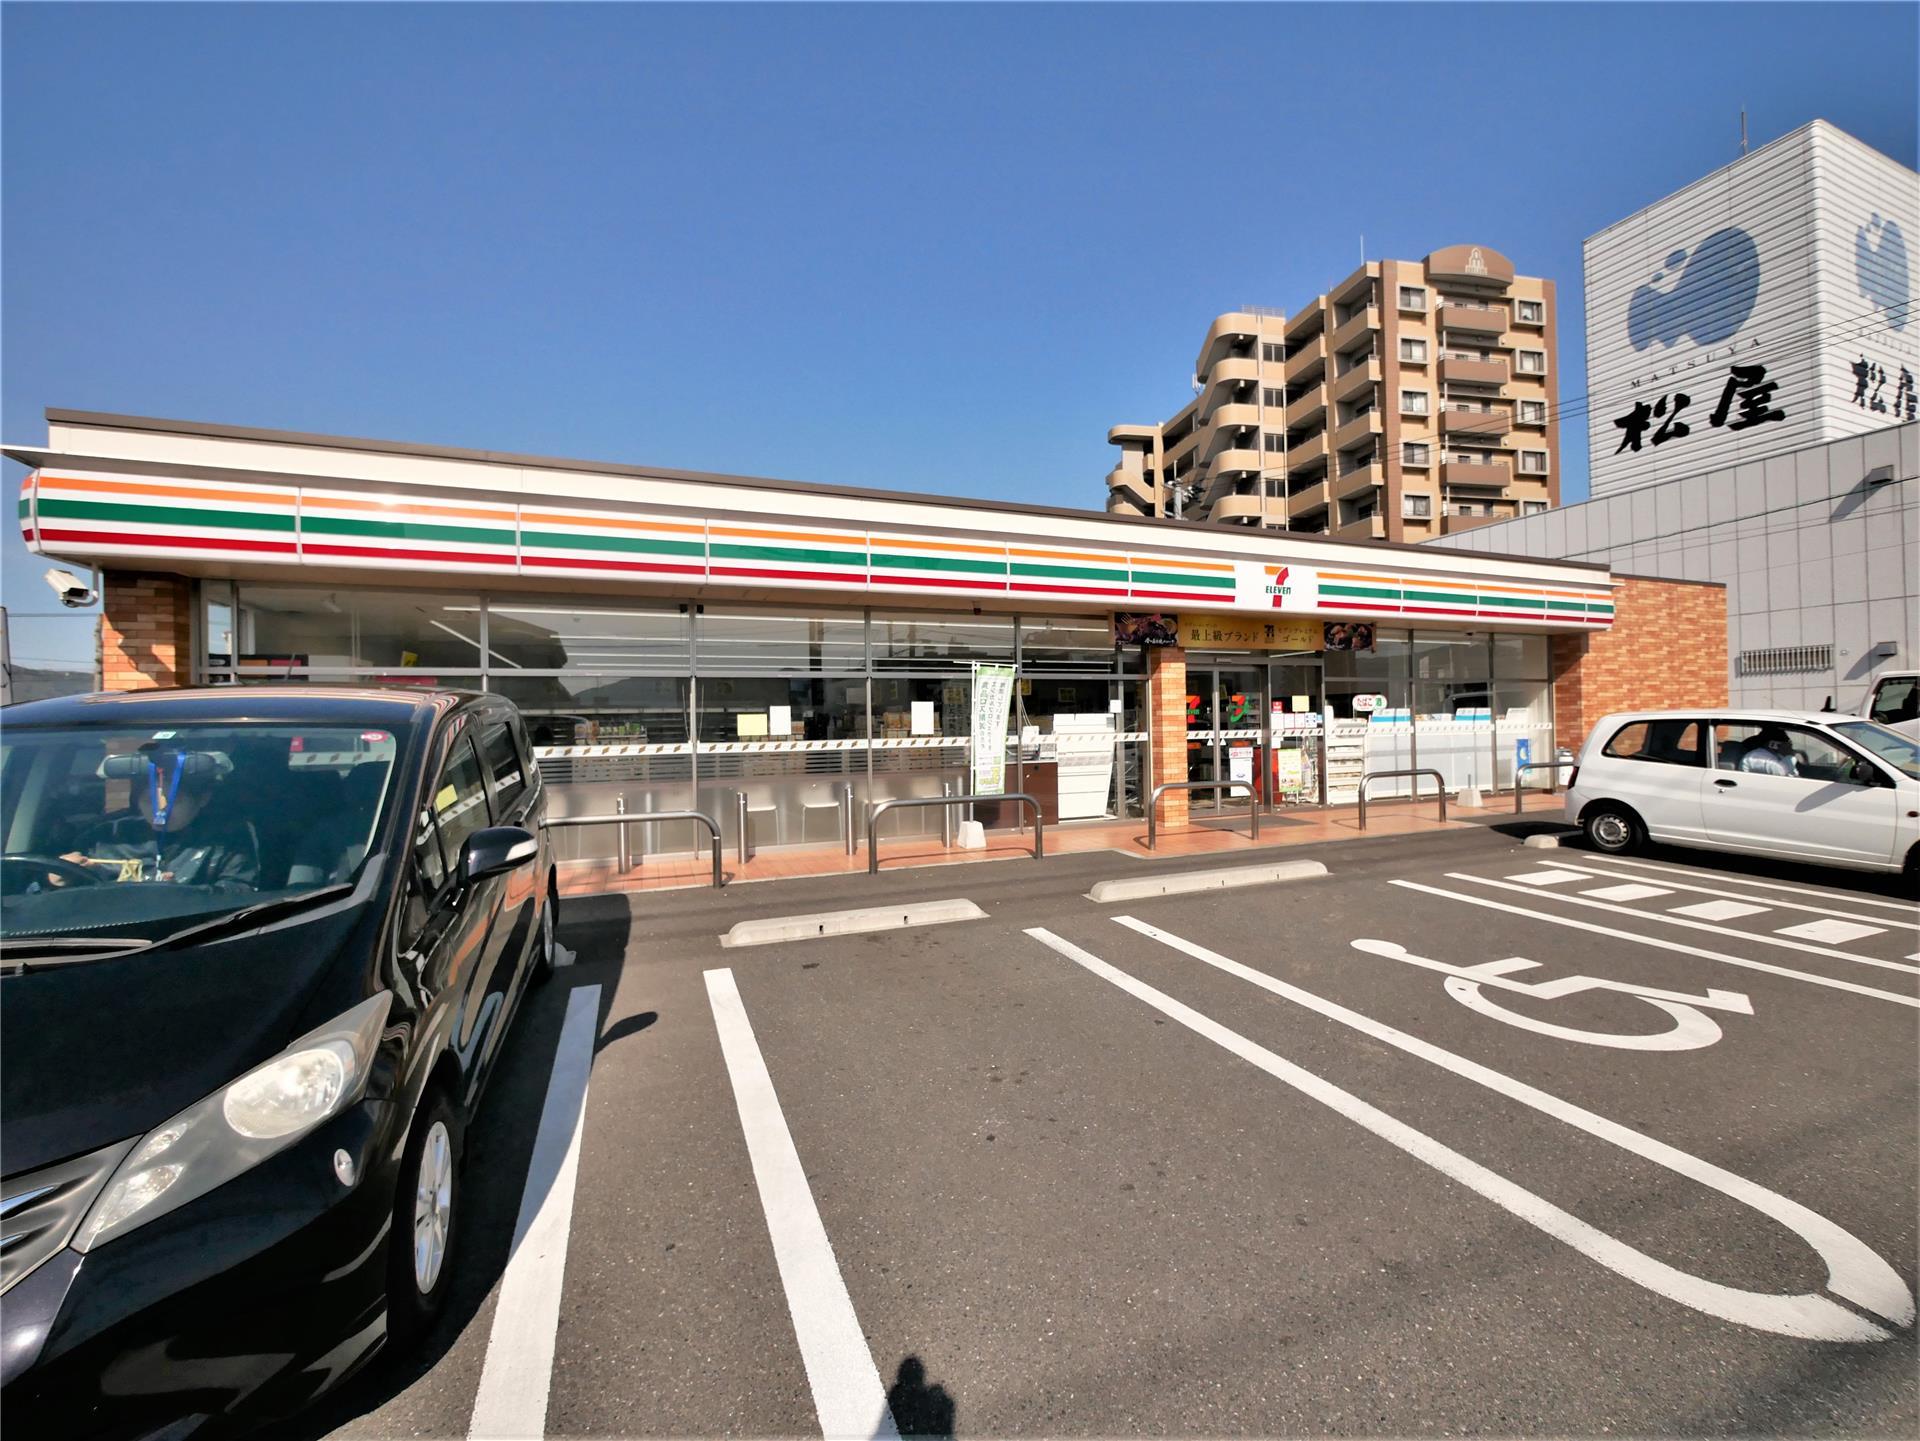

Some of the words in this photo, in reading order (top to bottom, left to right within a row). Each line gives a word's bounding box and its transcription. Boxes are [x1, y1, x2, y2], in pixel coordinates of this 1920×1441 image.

[1631, 338, 1760, 389] MATSUYA
[1613, 364, 1787, 456] 松屋
[1191, 629, 1259, 643] 最上級ブランド
